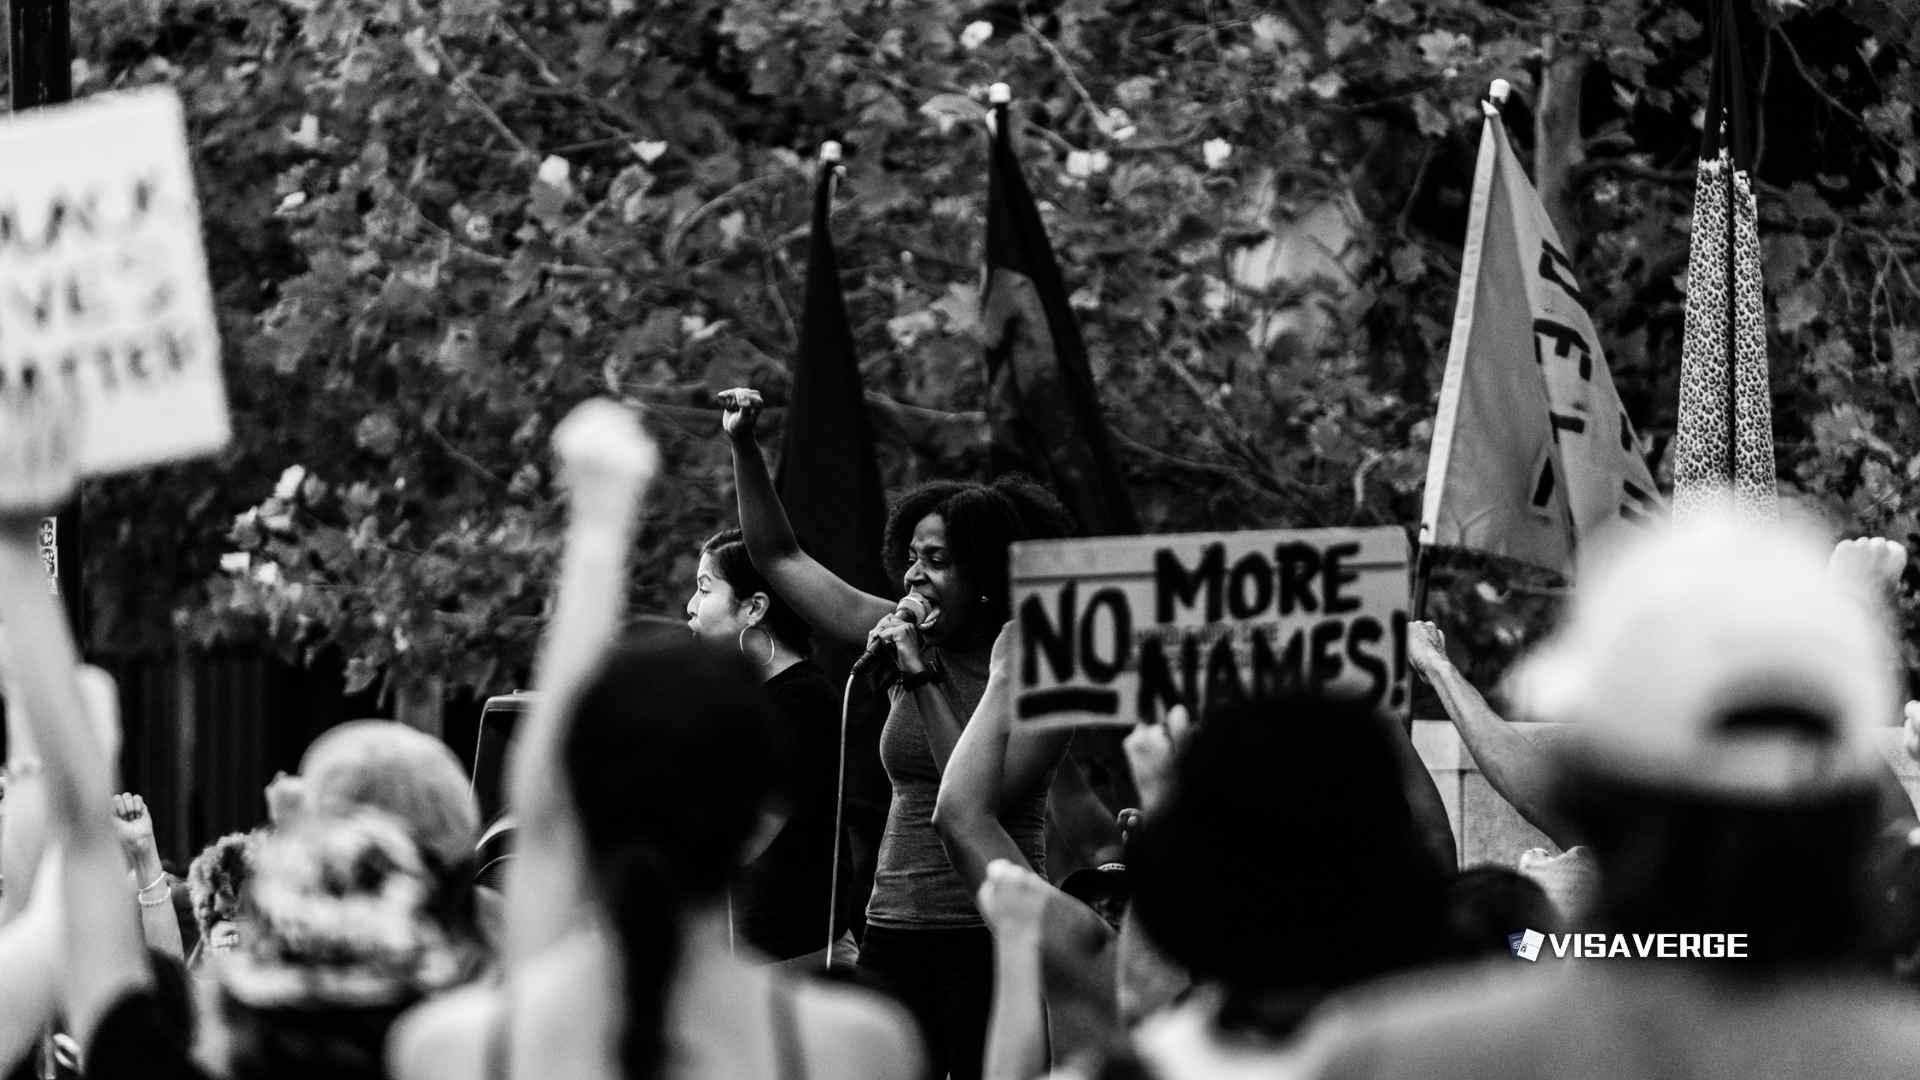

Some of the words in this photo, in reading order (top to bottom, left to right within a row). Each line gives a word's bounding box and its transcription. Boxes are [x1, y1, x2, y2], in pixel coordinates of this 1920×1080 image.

[1019, 580, 1132, 687] NO
[1153, 541, 1363, 624] MORE
[1137, 607, 1410, 732] NAMES!
